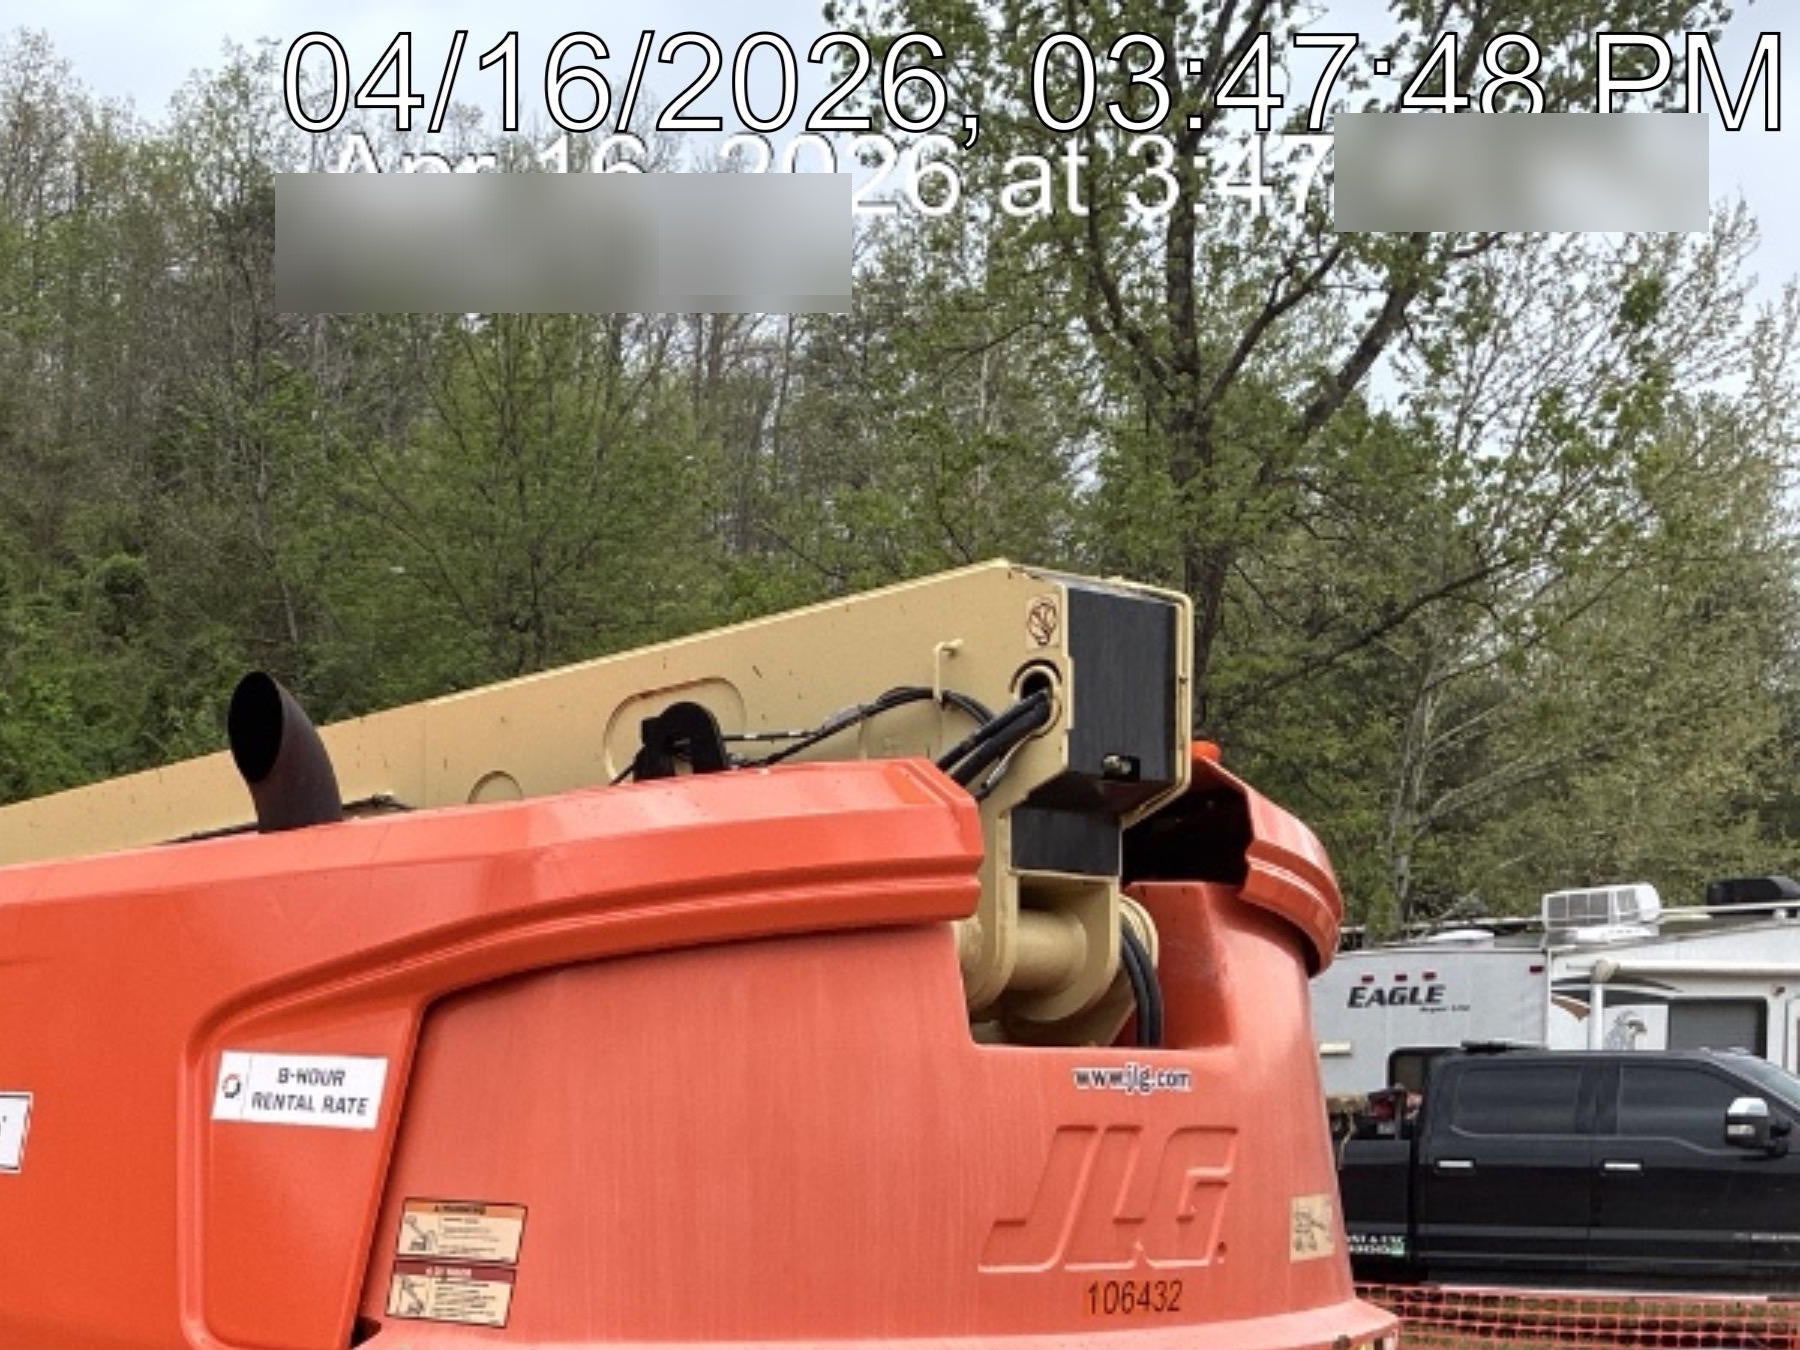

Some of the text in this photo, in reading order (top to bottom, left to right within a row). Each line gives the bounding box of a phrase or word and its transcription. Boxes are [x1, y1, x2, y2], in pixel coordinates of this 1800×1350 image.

[1347, 984, 1446, 1008] EAGLE
[1074, 1063, 1193, 1093] www.jlg.com
[251, 1091, 369, 1116] RENTAL RATE
[977, 1124, 1239, 1273] JLG
[1087, 1280, 1183, 1316] 106432
